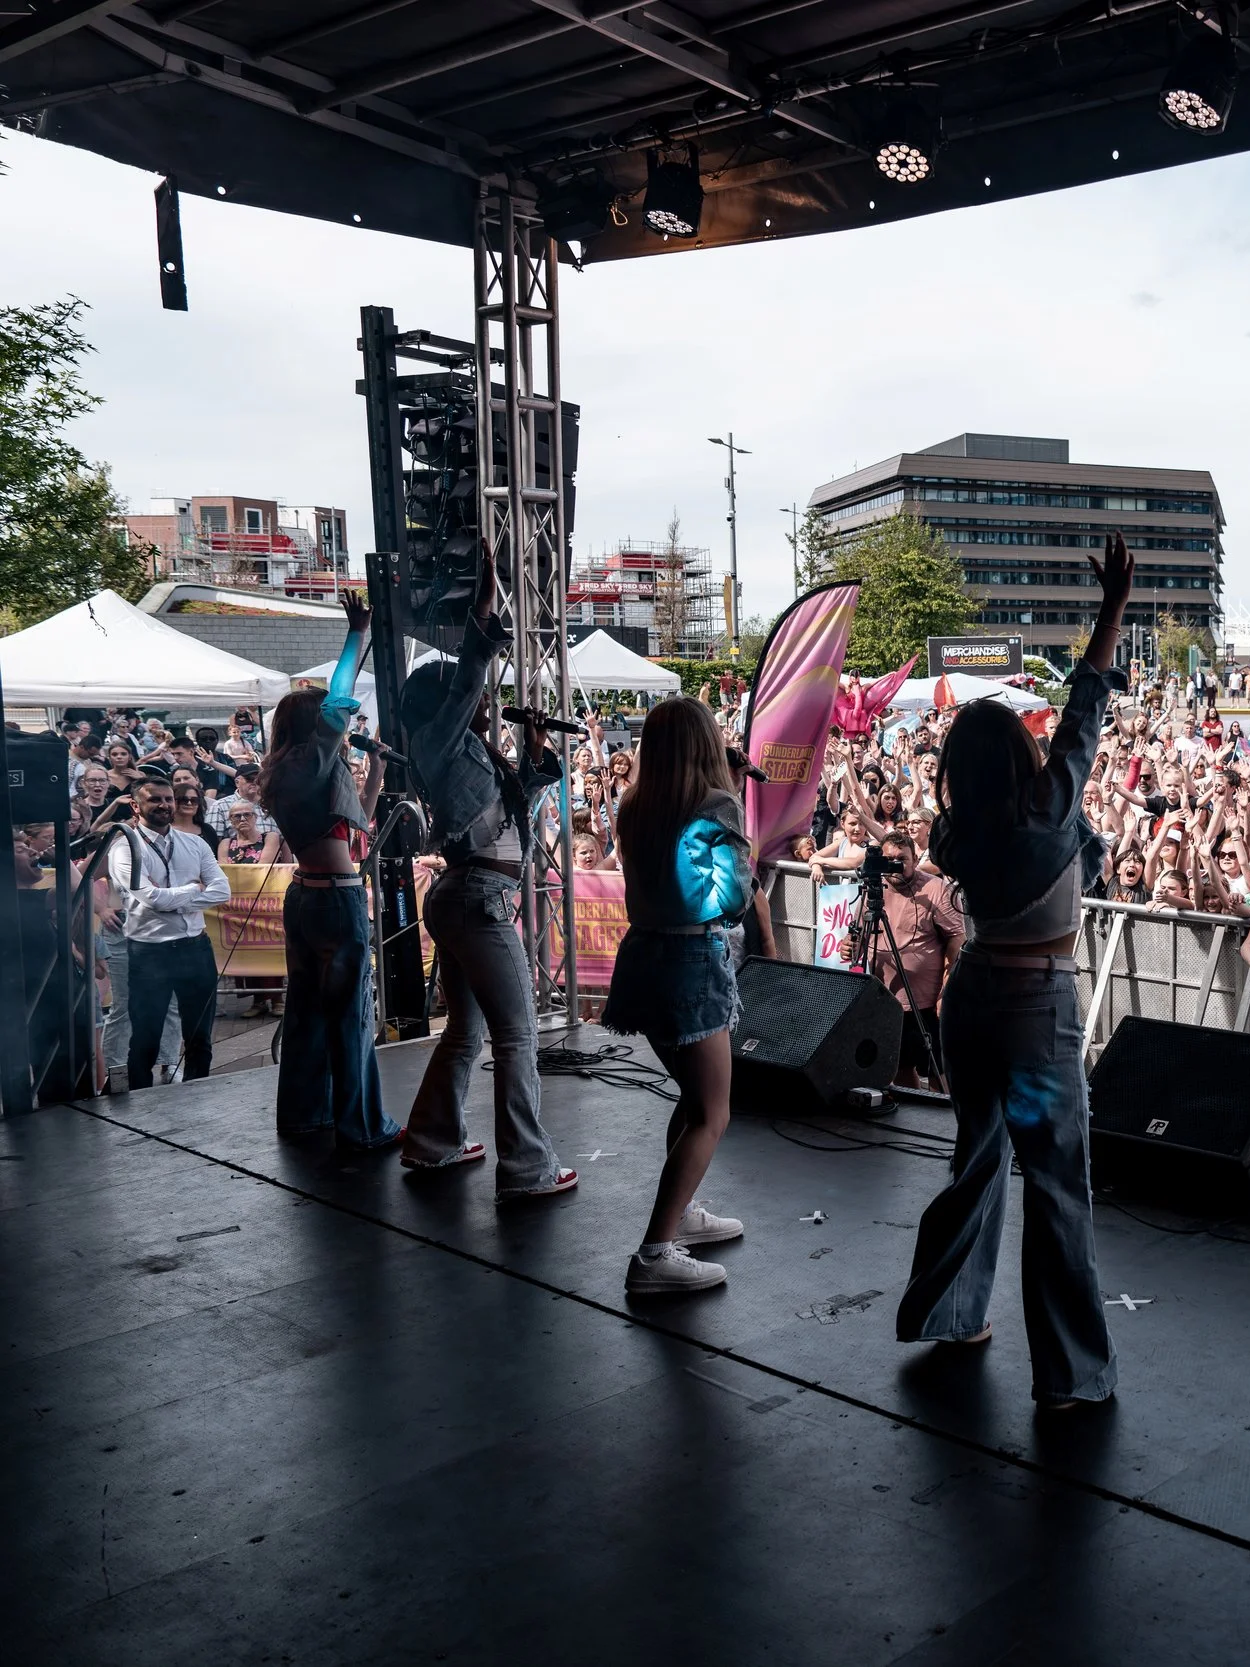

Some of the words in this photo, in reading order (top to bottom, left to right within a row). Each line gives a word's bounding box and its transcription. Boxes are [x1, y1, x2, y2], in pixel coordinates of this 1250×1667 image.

[943, 646, 1008, 657] MERCHANDISE
[945, 656, 959, 665] AND
[959, 656, 1008, 665] ACCESSORIES
[763, 744, 814, 758] SUNDERLAND
[764, 760, 807, 779] STAGES
[551, 901, 628, 919] DERLAN
[560, 924, 627, 951] AGES
